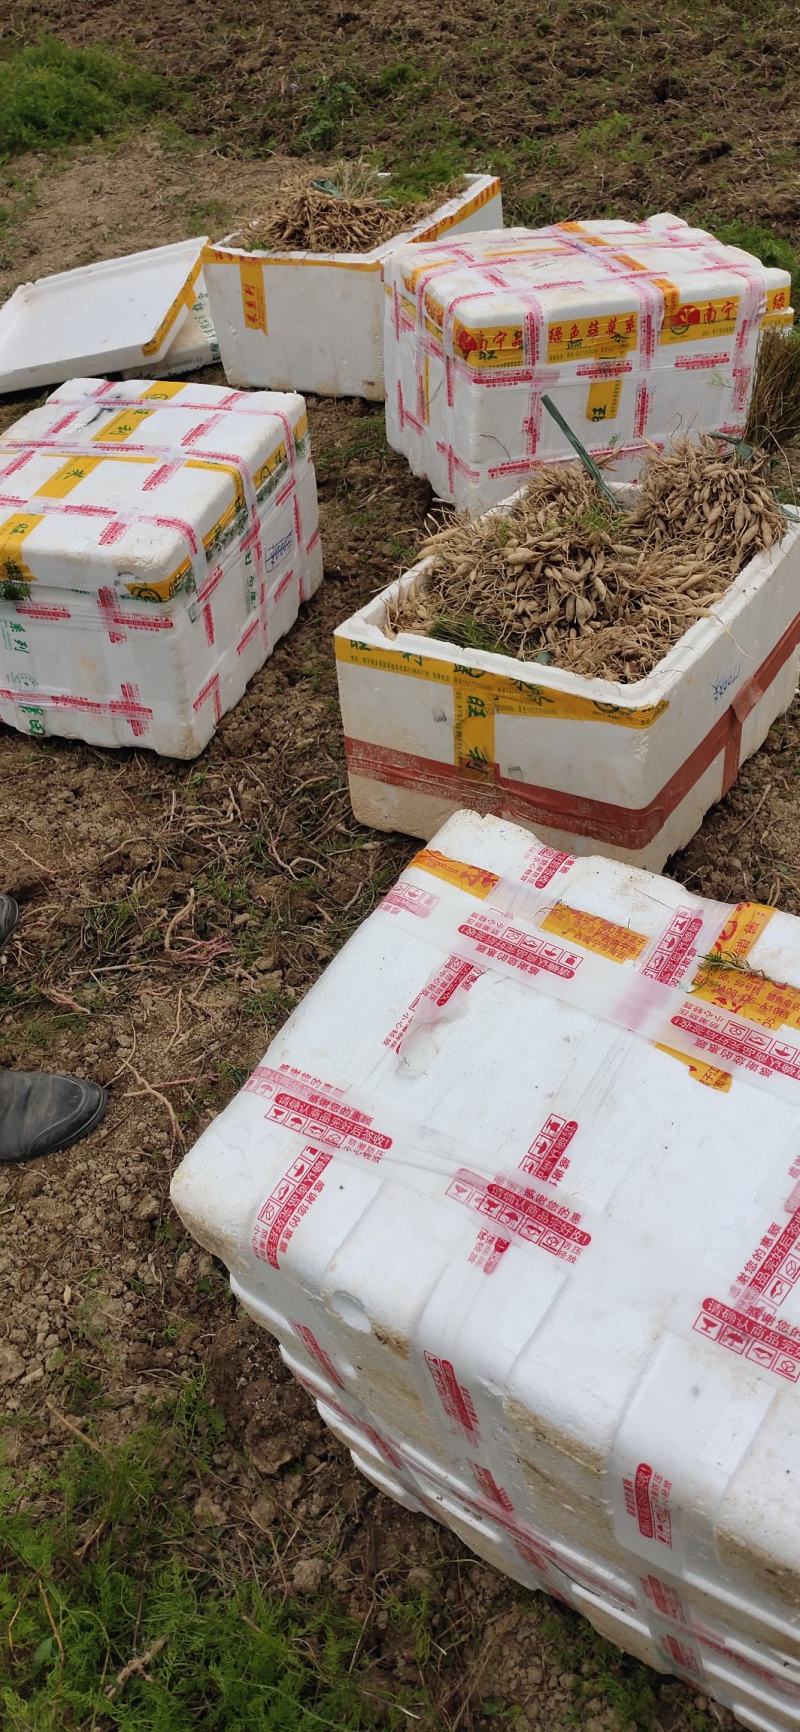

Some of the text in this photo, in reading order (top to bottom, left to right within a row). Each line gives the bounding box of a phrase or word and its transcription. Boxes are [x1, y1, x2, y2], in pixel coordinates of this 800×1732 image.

[460, 926, 571, 978] 请确认商品完好后签收!
[475, 944, 541, 976] 感谢您的惠顾
[692, 1037, 774, 1078] 感谢您的惠顾
[277, 1093, 391, 1150] 请确认商品完好后签收!
[346, 1137, 386, 1158] 防潮防压
